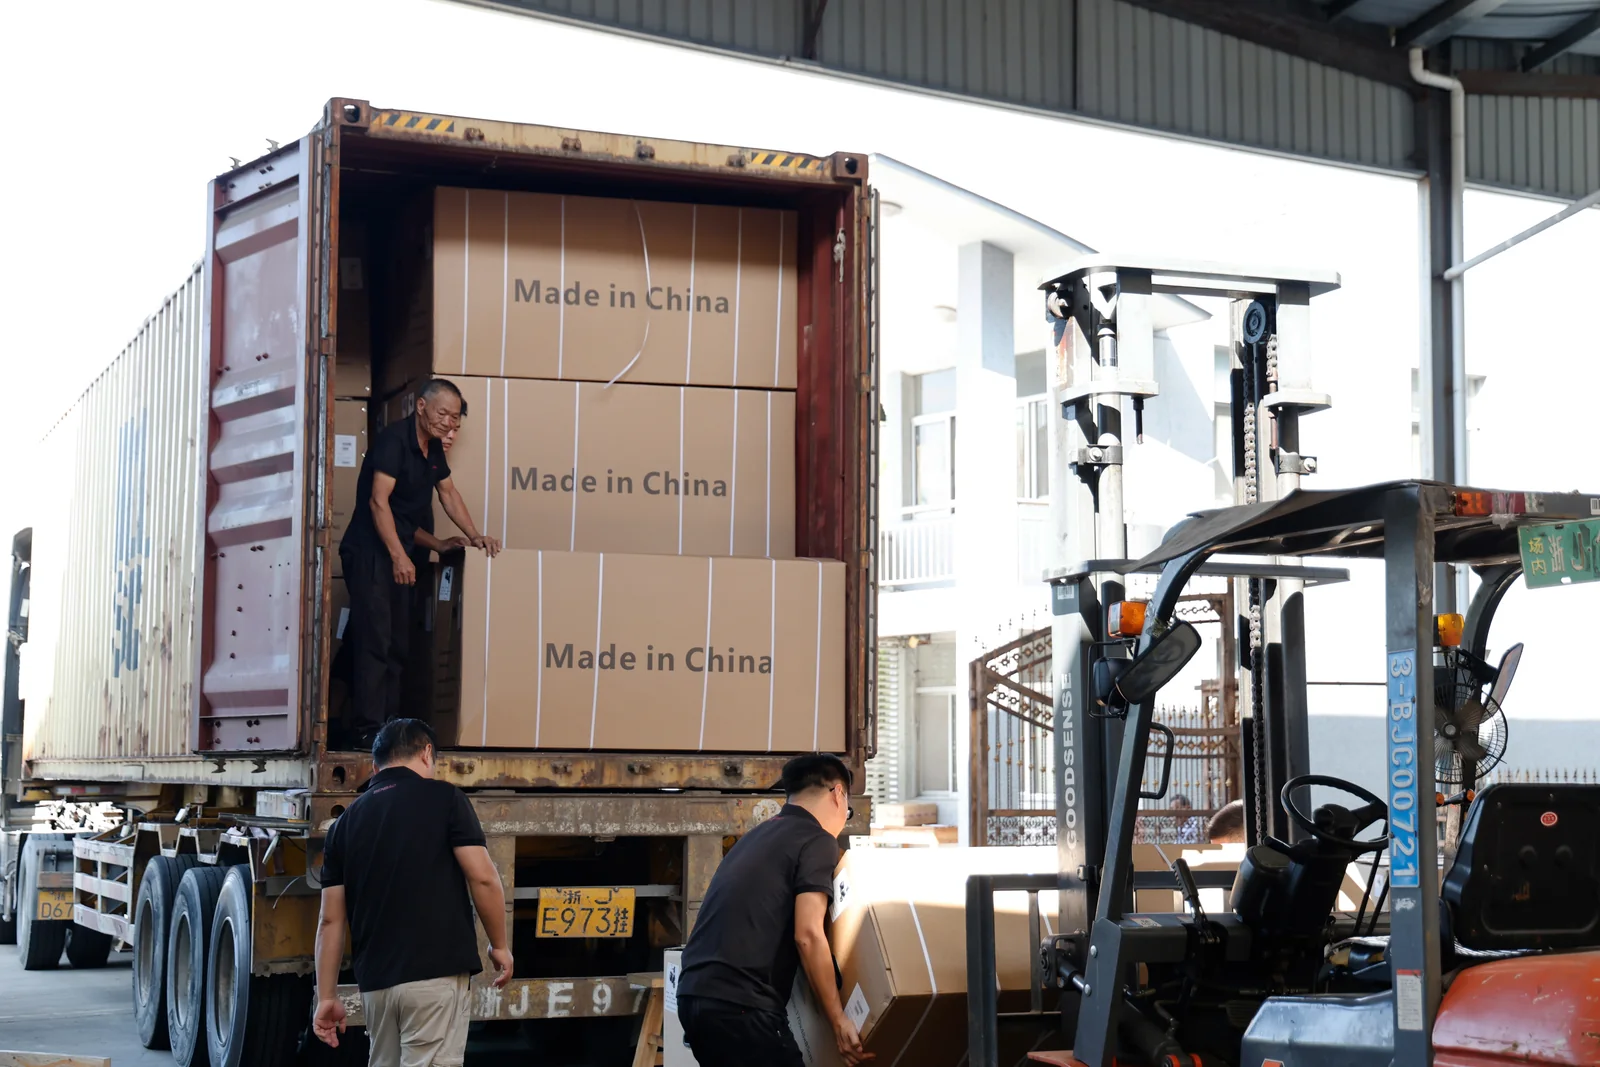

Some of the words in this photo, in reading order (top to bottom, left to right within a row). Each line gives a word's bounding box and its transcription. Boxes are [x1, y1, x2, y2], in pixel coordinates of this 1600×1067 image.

[514, 278, 600, 307] Made
[609, 283, 636, 309] in
[645, 286, 730, 314] China
[511, 466, 597, 493] Made
[606, 468, 633, 494] in
[642, 470, 727, 497] China
[545, 642, 637, 671] Made
[646, 644, 675, 672] in
[685, 646, 773, 674] China
[1061, 672, 1077, 850] GOODSENSE
[1391, 657, 1416, 877] 3-BJC00721
[541, 906, 629, 934] E973挂
